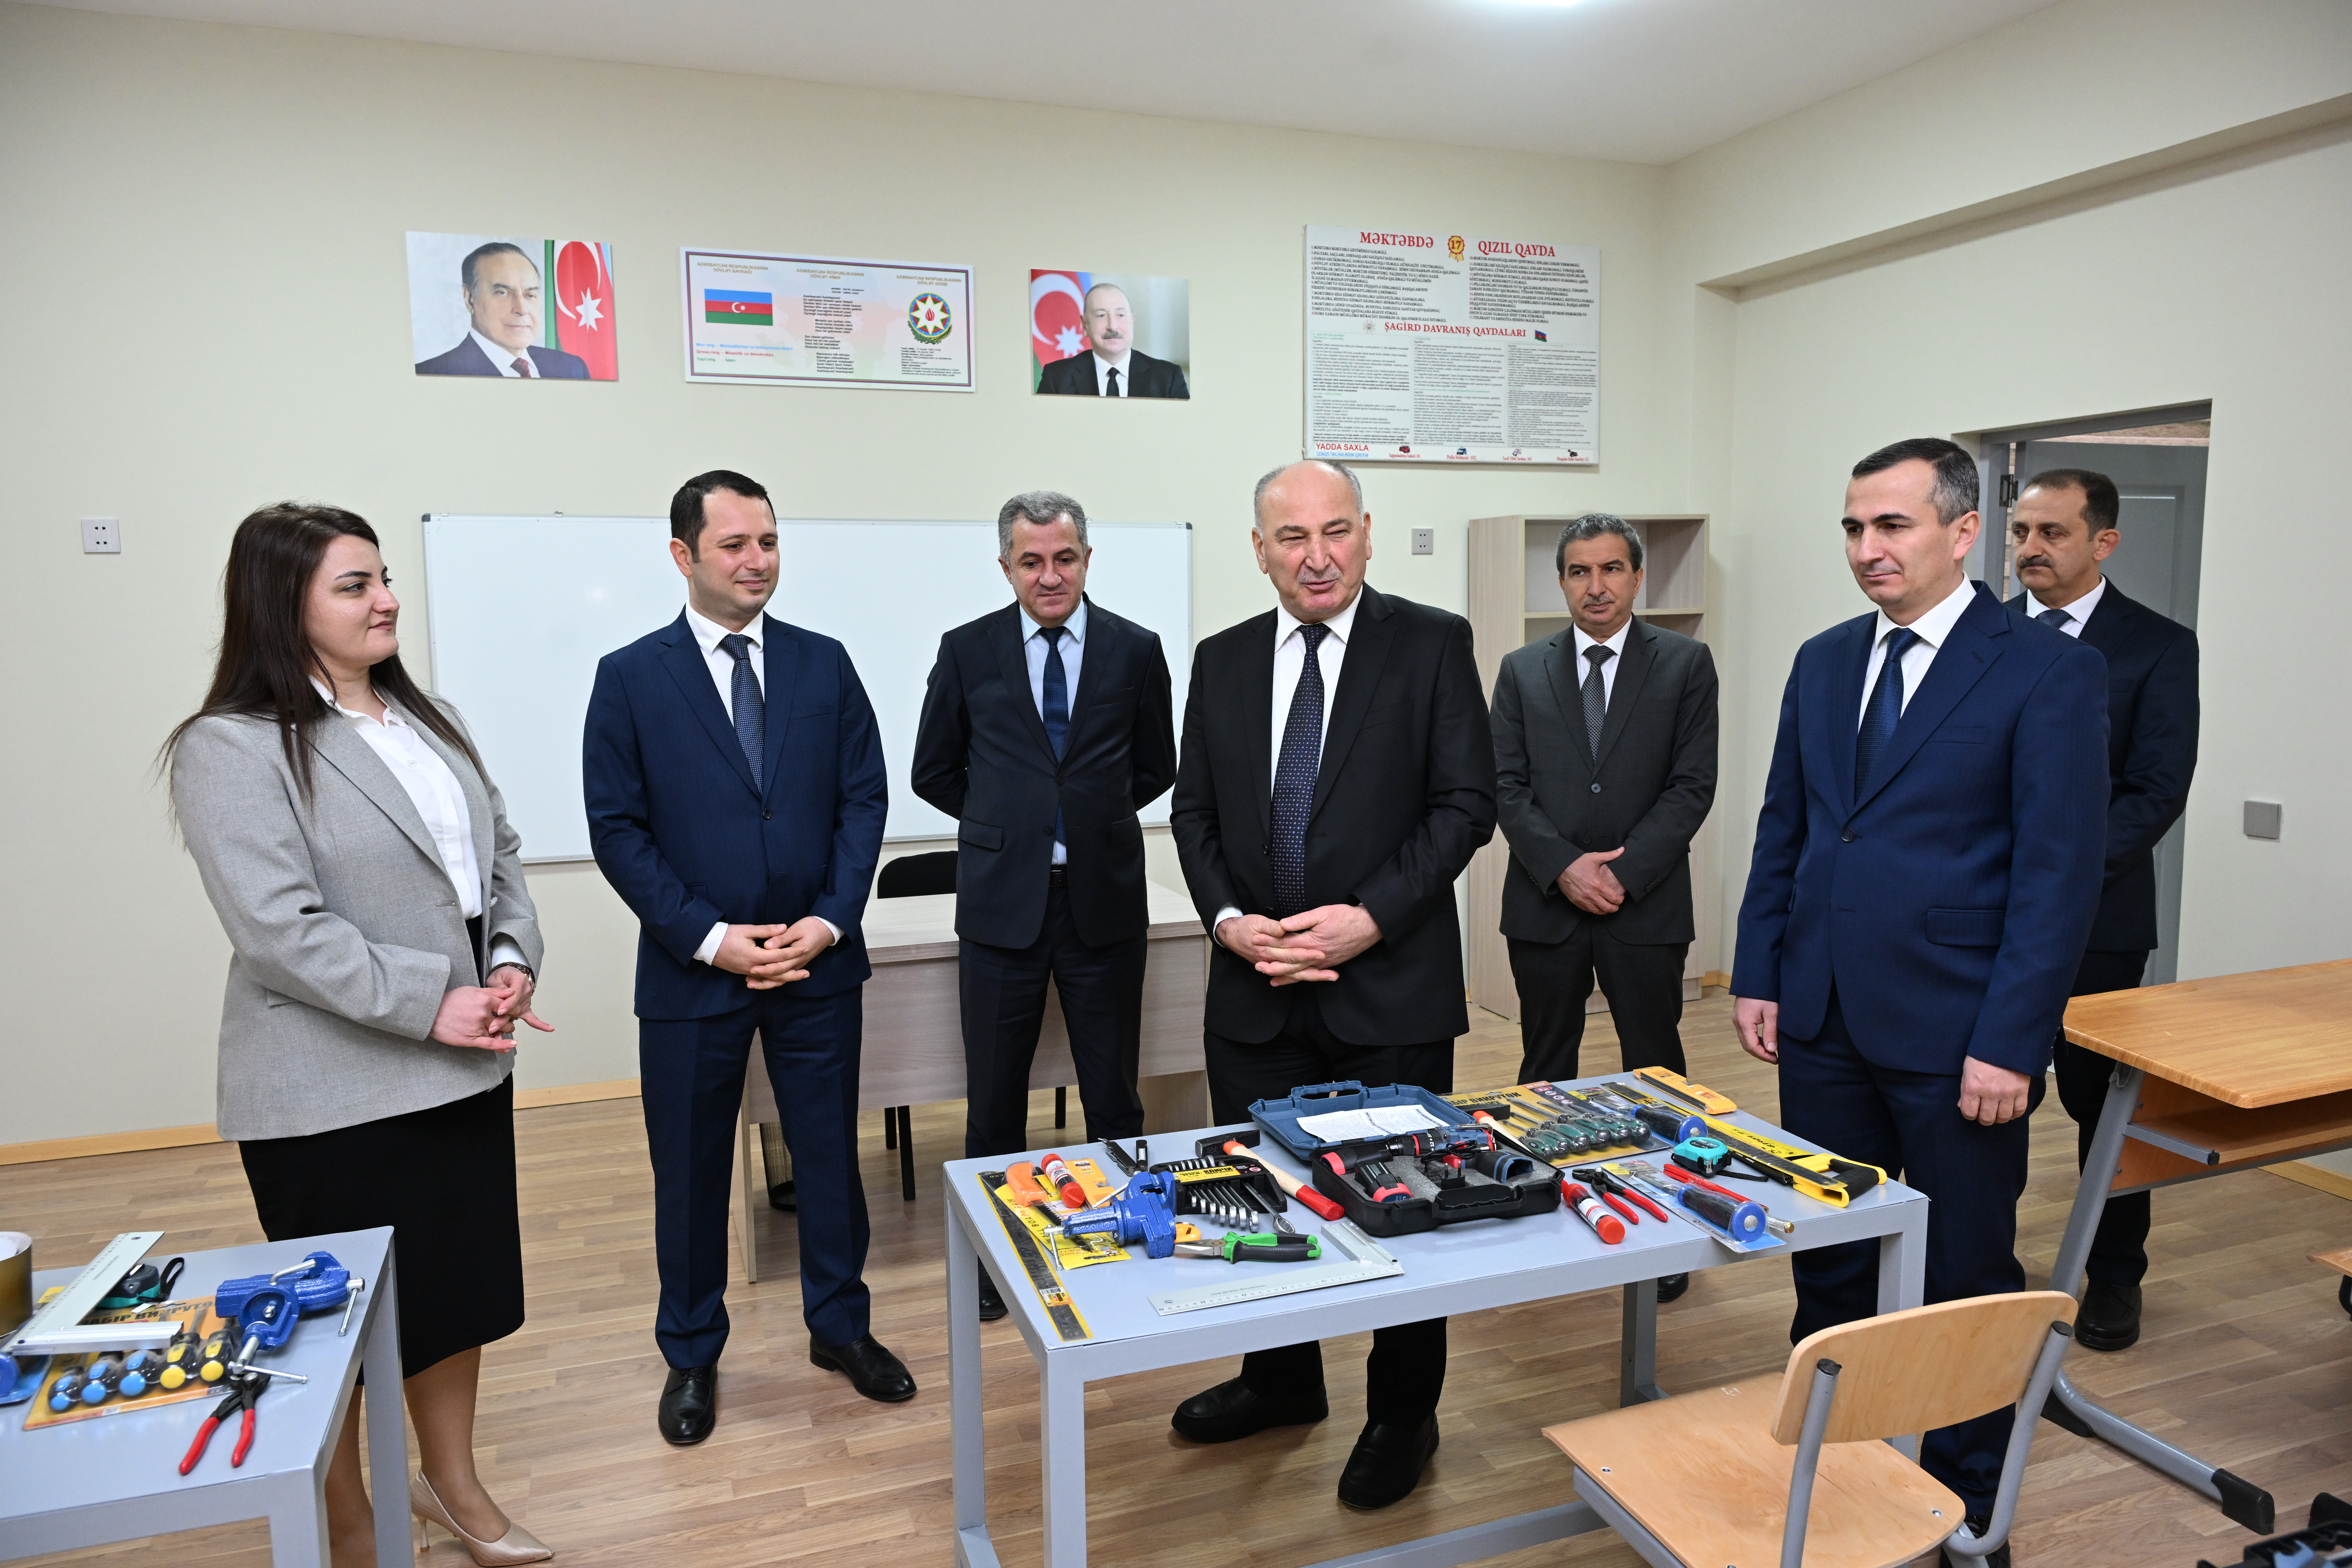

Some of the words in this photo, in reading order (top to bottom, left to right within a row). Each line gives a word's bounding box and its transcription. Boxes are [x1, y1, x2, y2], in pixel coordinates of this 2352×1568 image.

[1359, 232, 1434, 248] MƏKTƏBDƏ
[1451, 240, 1462, 250] 17
[1478, 240, 1512, 255] QIZIL
[1515, 243, 1556, 258] QAYDA
[1384, 321, 1421, 332] ŞAGİRD
[1423, 325, 1471, 336] DAVRANIŞ
[1473, 327, 1526, 337] QAYDALARI
[1468, 1092, 1522, 1103] ВИКРУТОК
[1020, 1211, 1039, 1227] BOARD
[135, 1301, 216, 1319] ВИКРУТО
